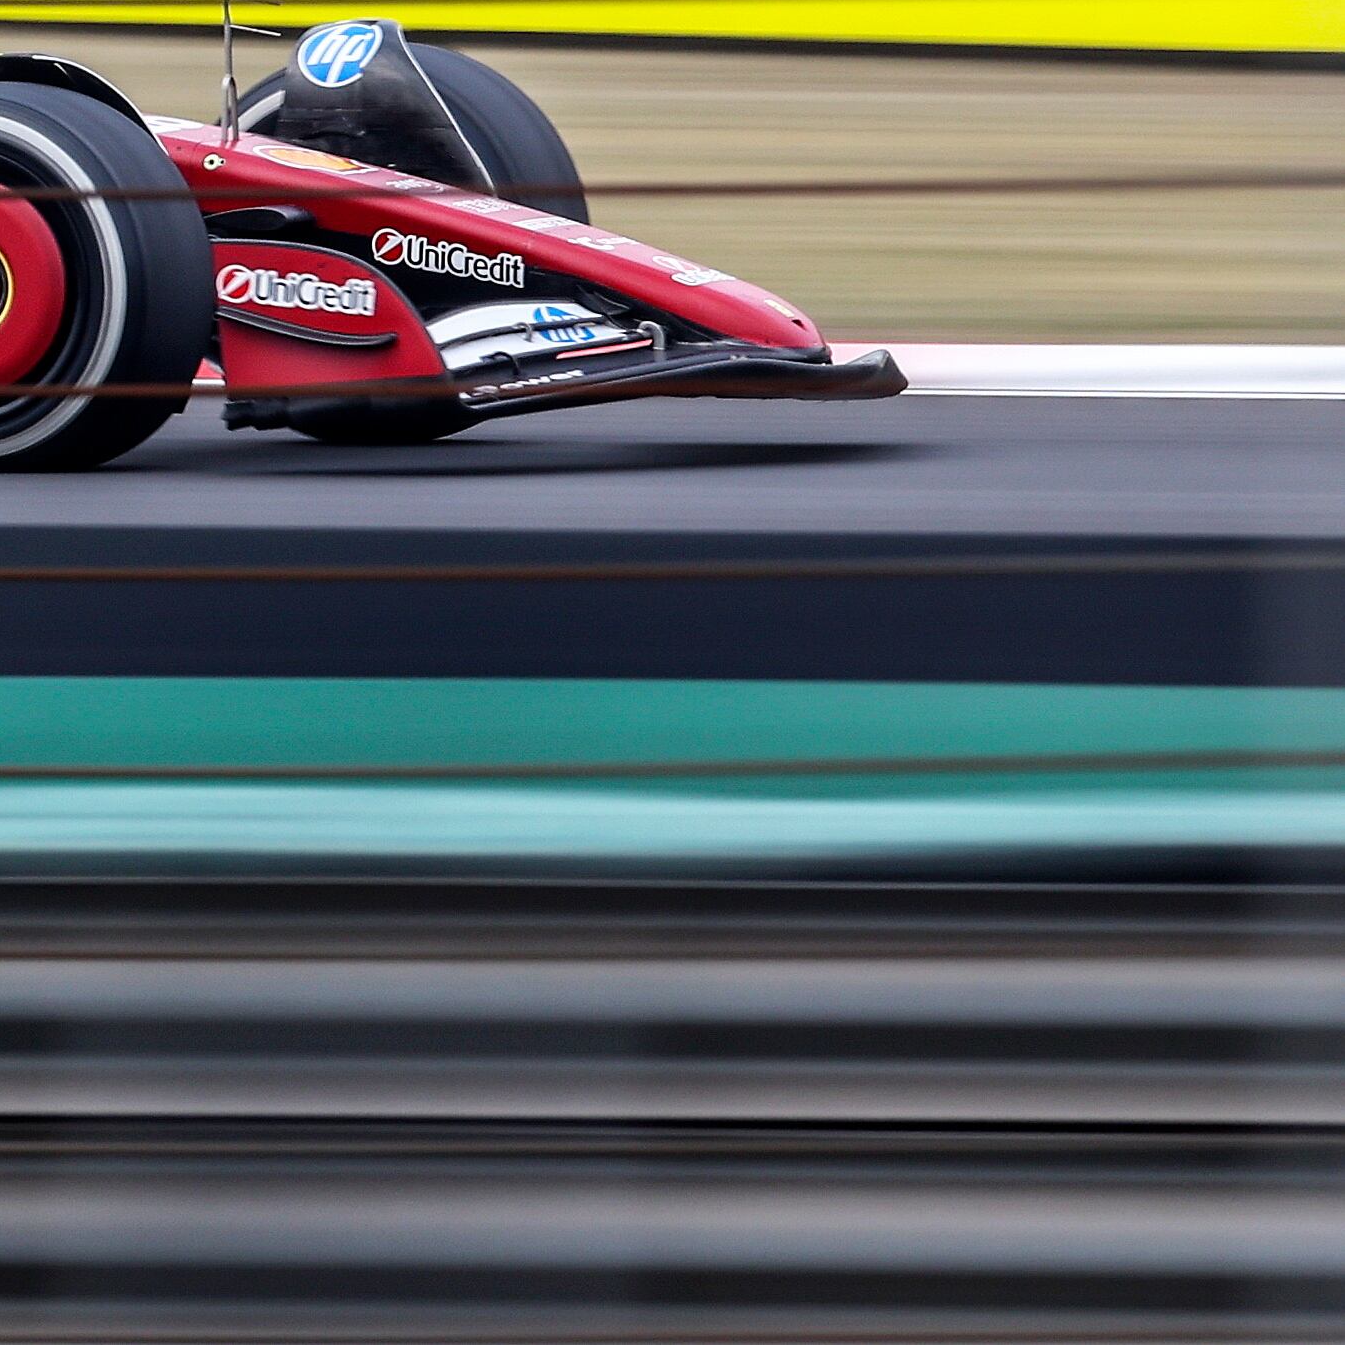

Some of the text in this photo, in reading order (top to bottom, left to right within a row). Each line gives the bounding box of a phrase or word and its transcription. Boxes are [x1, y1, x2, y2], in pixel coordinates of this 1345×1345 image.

[306, 28, 375, 85] hp
[405, 234, 524, 288] UniCredit
[253, 269, 377, 316] UniCredit
